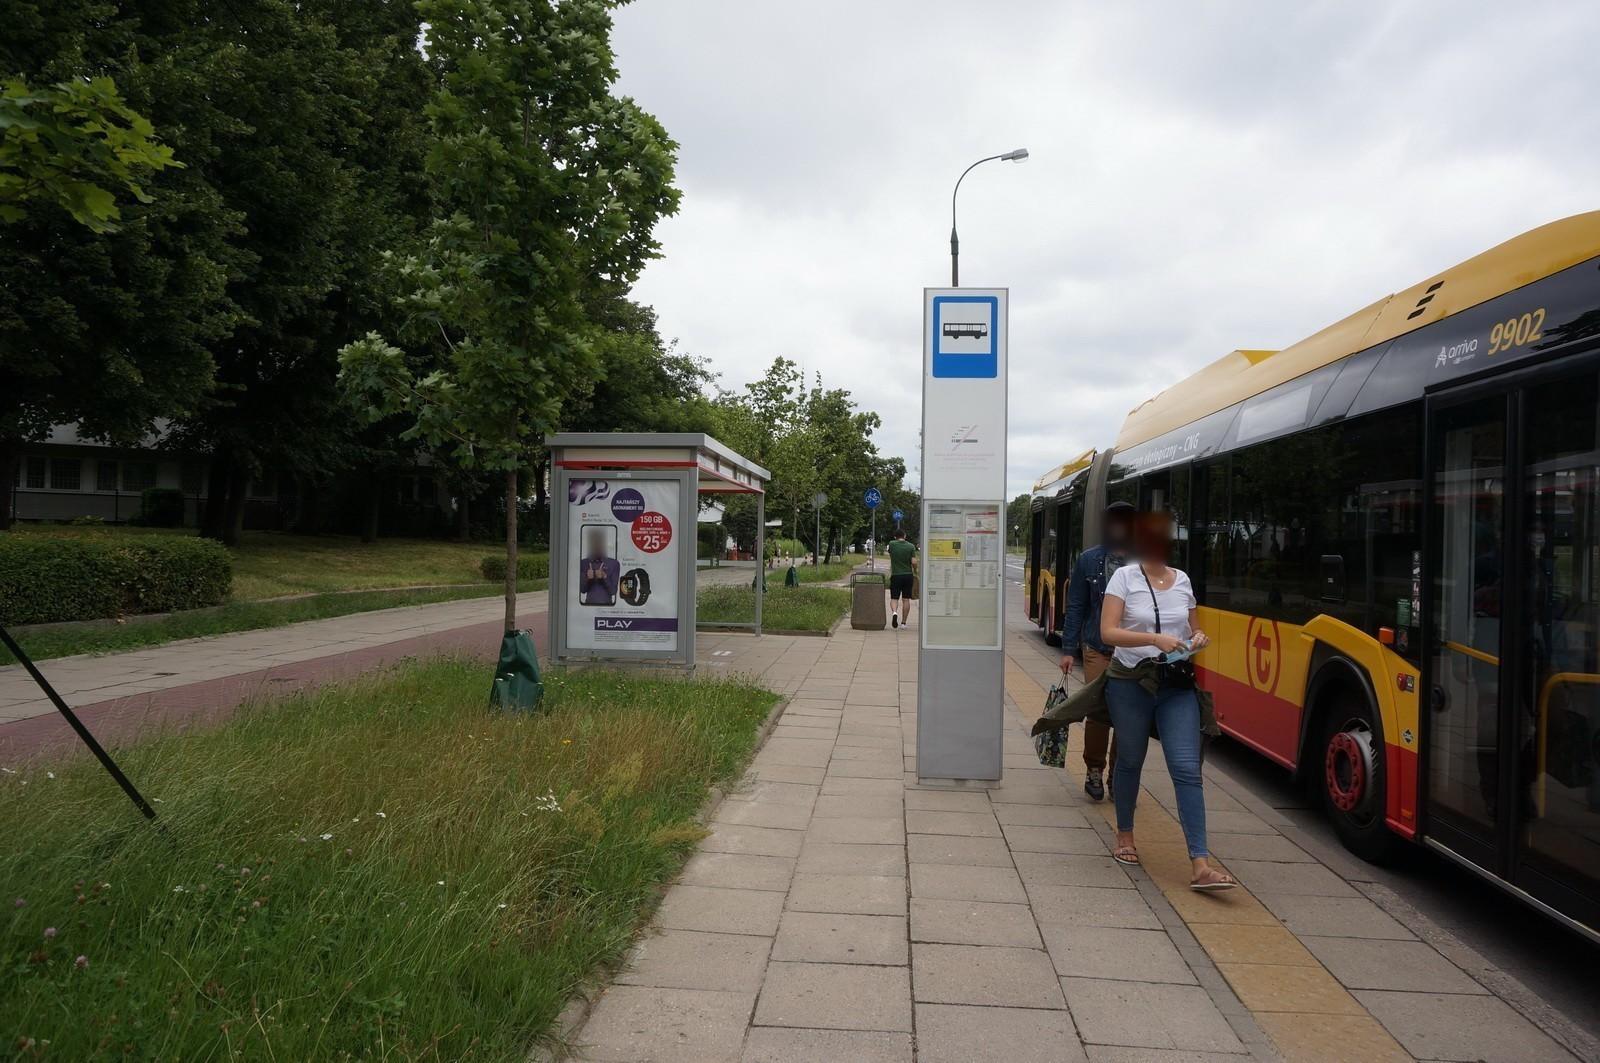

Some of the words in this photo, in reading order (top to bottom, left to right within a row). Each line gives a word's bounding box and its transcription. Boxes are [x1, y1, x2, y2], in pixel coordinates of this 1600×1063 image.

[1488, 308, 1546, 356] 9902
[1448, 338, 1478, 359] arriva
[1184, 432, 1200, 452] CNG
[639, 515, 653, 524] 150
[652, 515, 663, 524] GB
[643, 535, 660, 550] 25
[597, 620, 632, 628] PLAY
